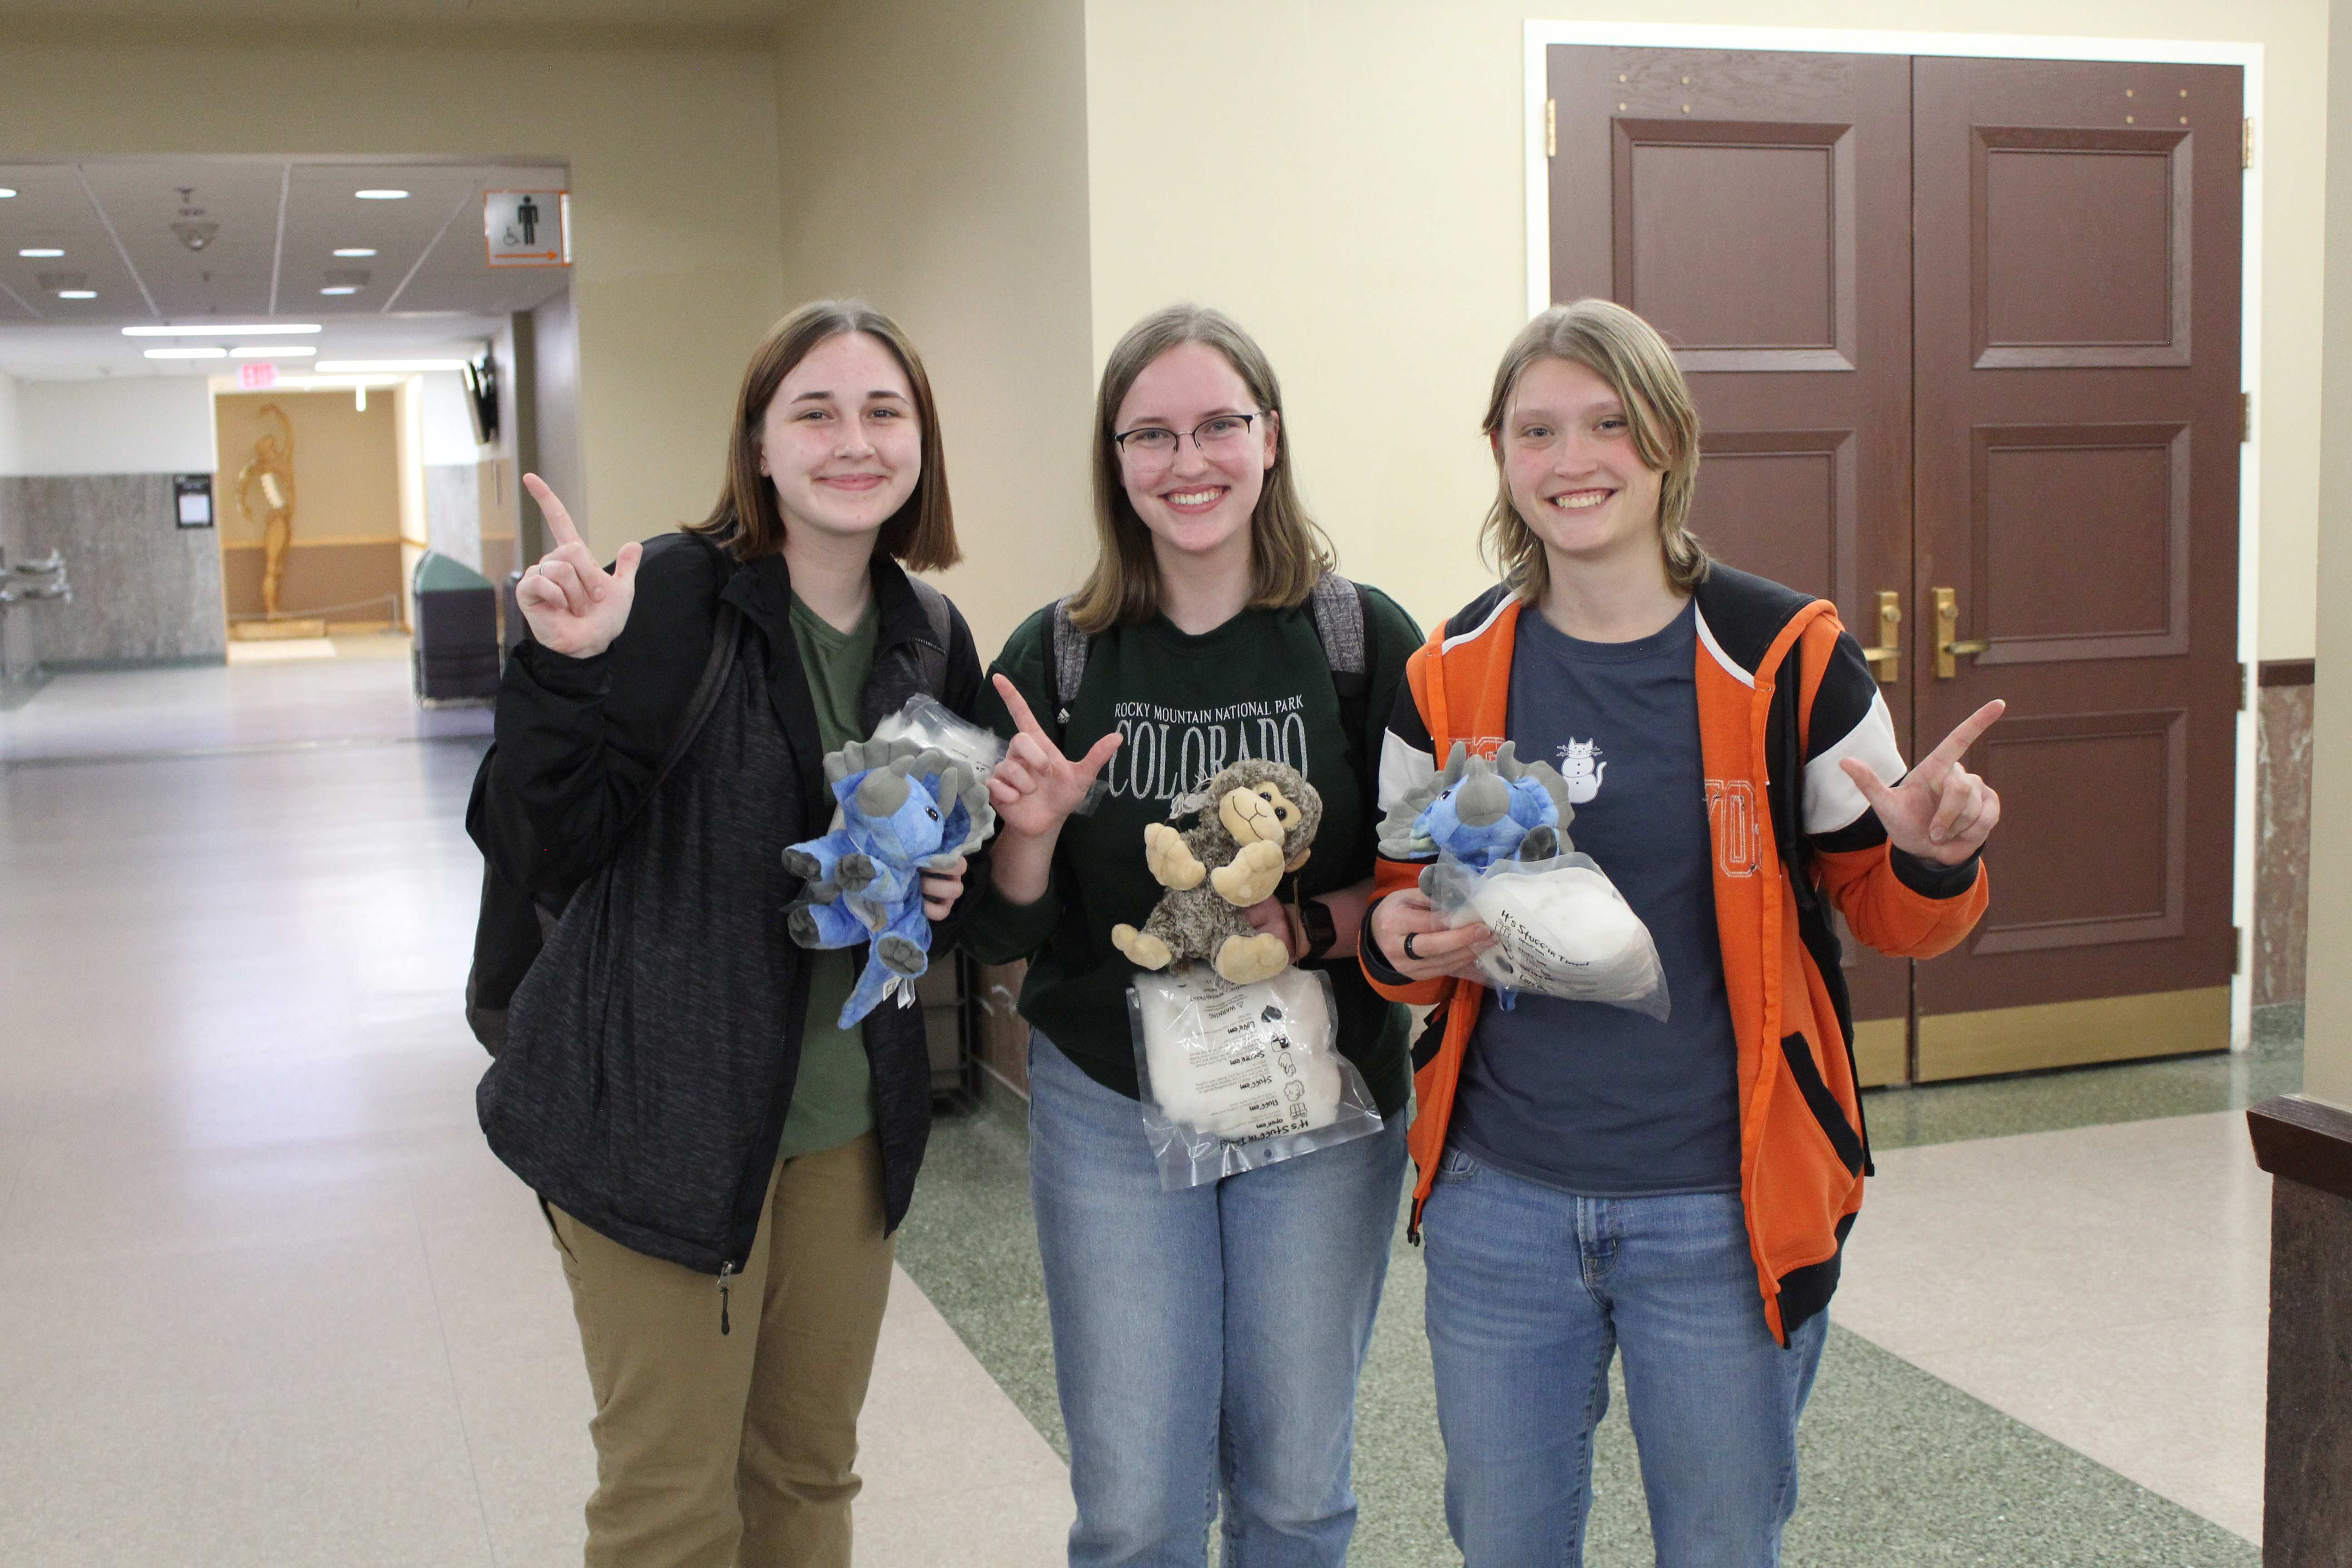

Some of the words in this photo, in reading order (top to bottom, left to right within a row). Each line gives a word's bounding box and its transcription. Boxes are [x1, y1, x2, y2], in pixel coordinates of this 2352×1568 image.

[1114, 702, 1150, 718] ROCKY
[1154, 705, 1211, 724] MOUNTAIN
[1215, 701, 1271, 722] NATIONAL
[1274, 694, 1303, 714] PARK
[1209, 1005, 1236, 1019] WARNING
[1291, 1119, 1308, 1130] It's
